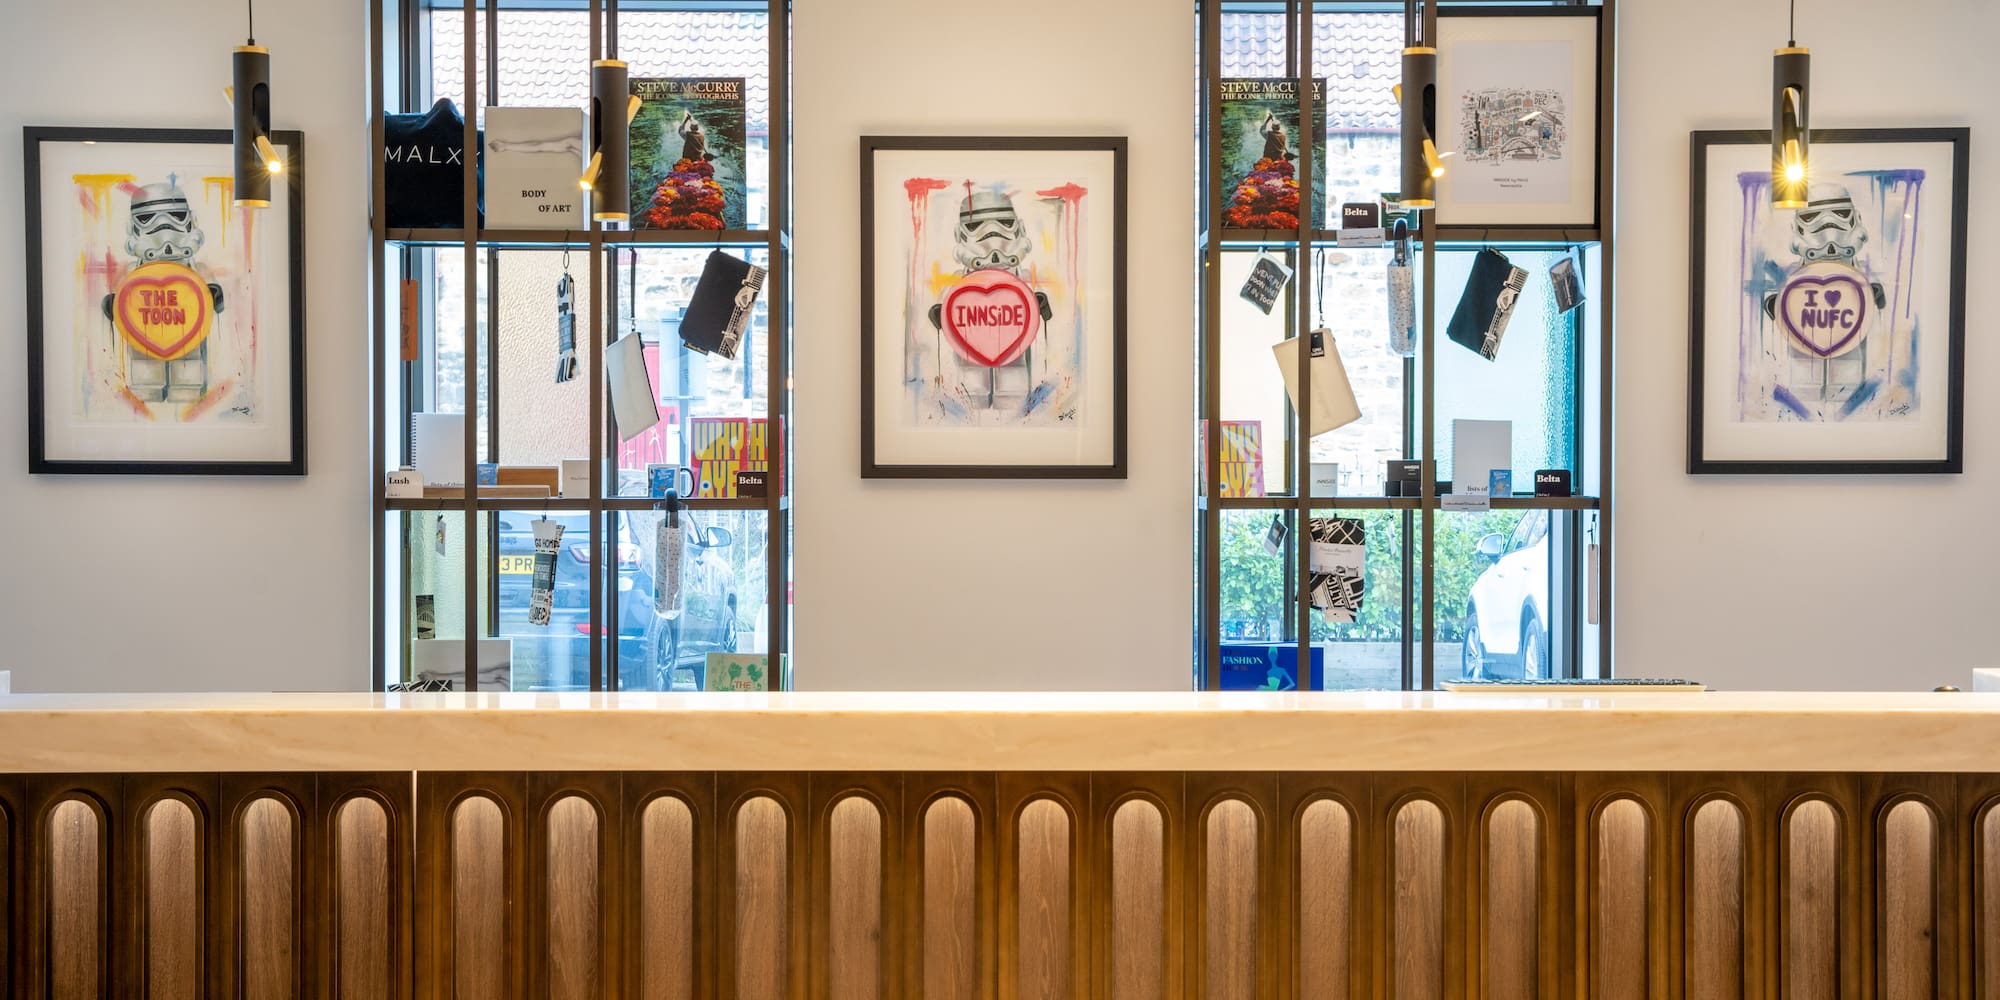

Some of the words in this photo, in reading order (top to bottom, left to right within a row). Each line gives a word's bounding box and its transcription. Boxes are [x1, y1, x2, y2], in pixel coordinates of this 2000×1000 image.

[637, 81, 678, 93] STEVE
[680, 81, 741, 93] McCURRY
[1220, 81, 1260, 93] STEVE
[1262, 81, 1322, 93] McCUY
[521, 190, 547, 198] BODY
[538, 204, 551, 213] OF
[552, 204, 572, 213] ART
[1344, 207, 1369, 216] Belta
[139, 289, 178, 306] THE
[1804, 290, 1819, 307] I
[138, 307, 186, 326] TOON
[1801, 308, 1855, 329] NUFC
[694, 421, 744, 460] WHY
[388, 477, 410, 485] Lush
[698, 460, 739, 498] AYE
[739, 476, 763, 485] Belta
[1536, 474, 1561, 483] Belta
[502, 557, 510, 571] 3
[514, 557, 533, 571] PR
[1222, 655, 1264, 665] FASHION
[734, 680, 752, 689] THE
